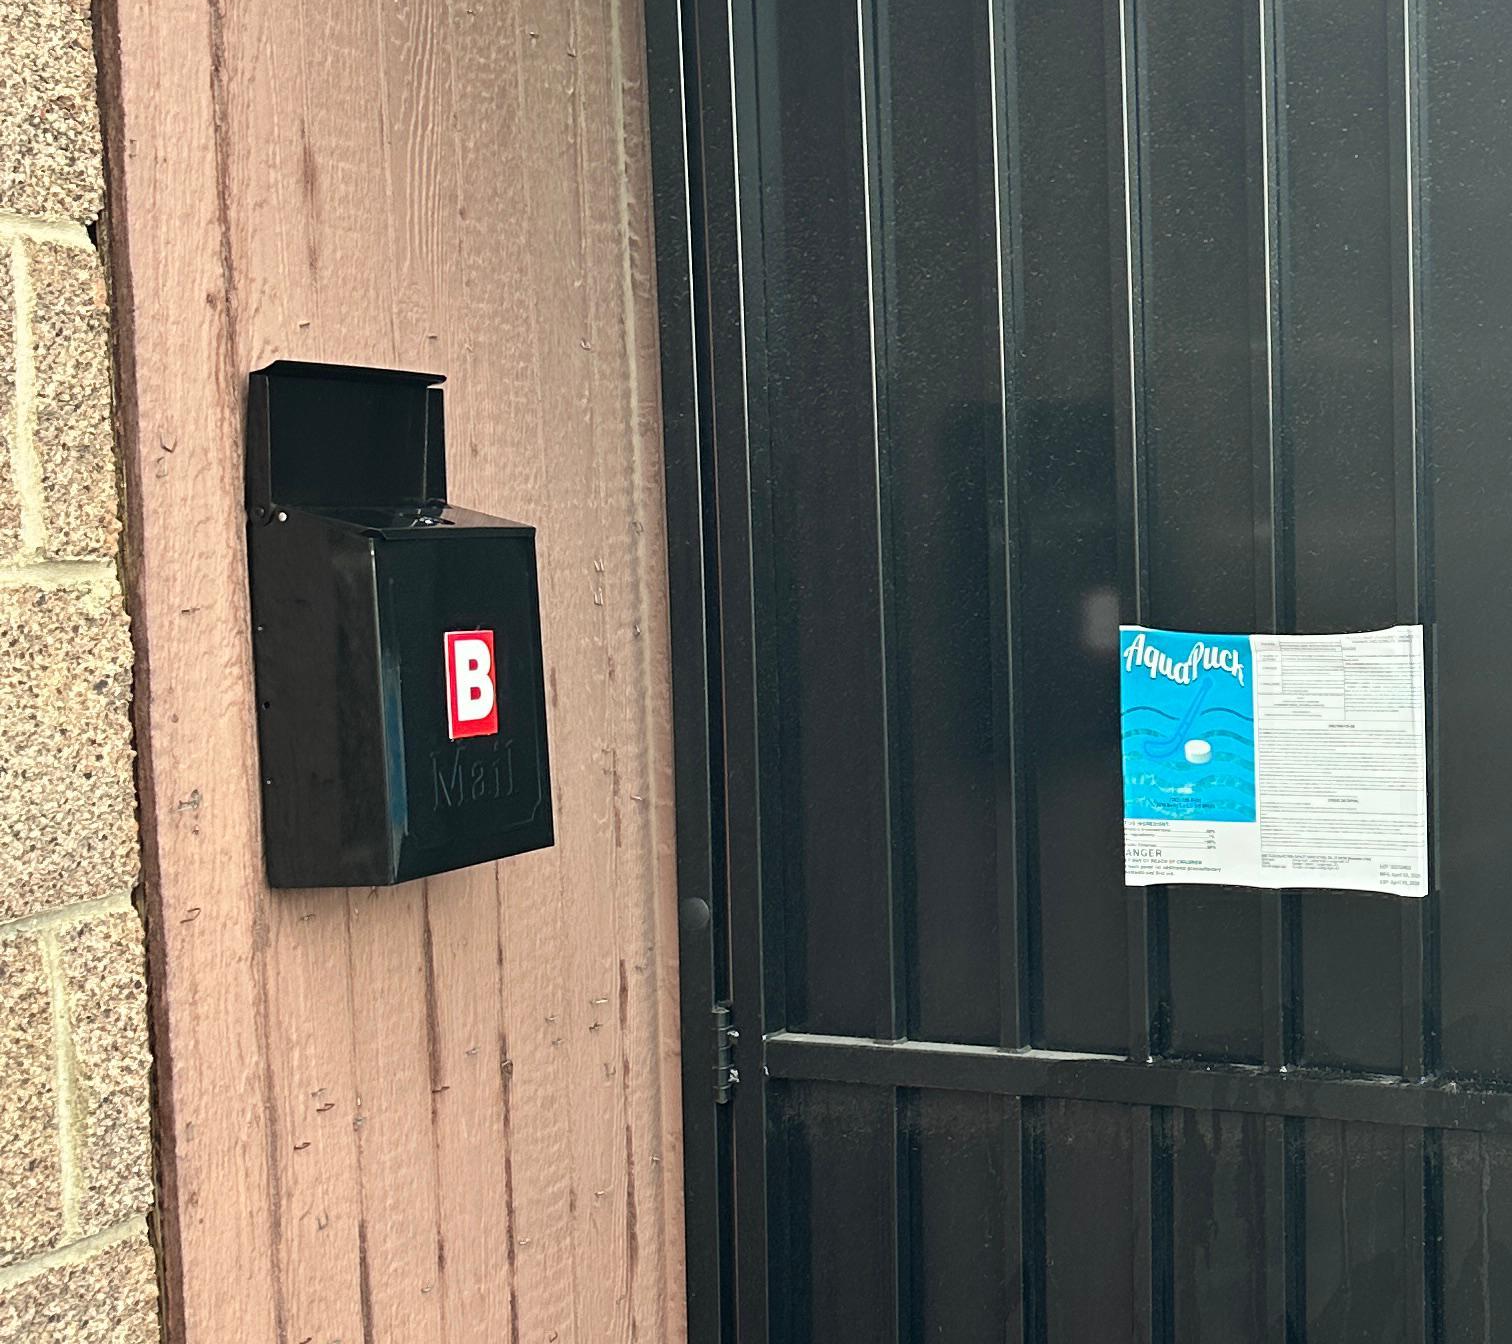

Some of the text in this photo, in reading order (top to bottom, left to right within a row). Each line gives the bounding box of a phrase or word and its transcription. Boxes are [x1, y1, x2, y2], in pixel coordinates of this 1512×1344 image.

[454, 639, 494, 722] B
[1123, 633, 1245, 687] AquaPuck
[430, 740, 516, 810] Mail
[1125, 848, 1162, 857] ANGER
